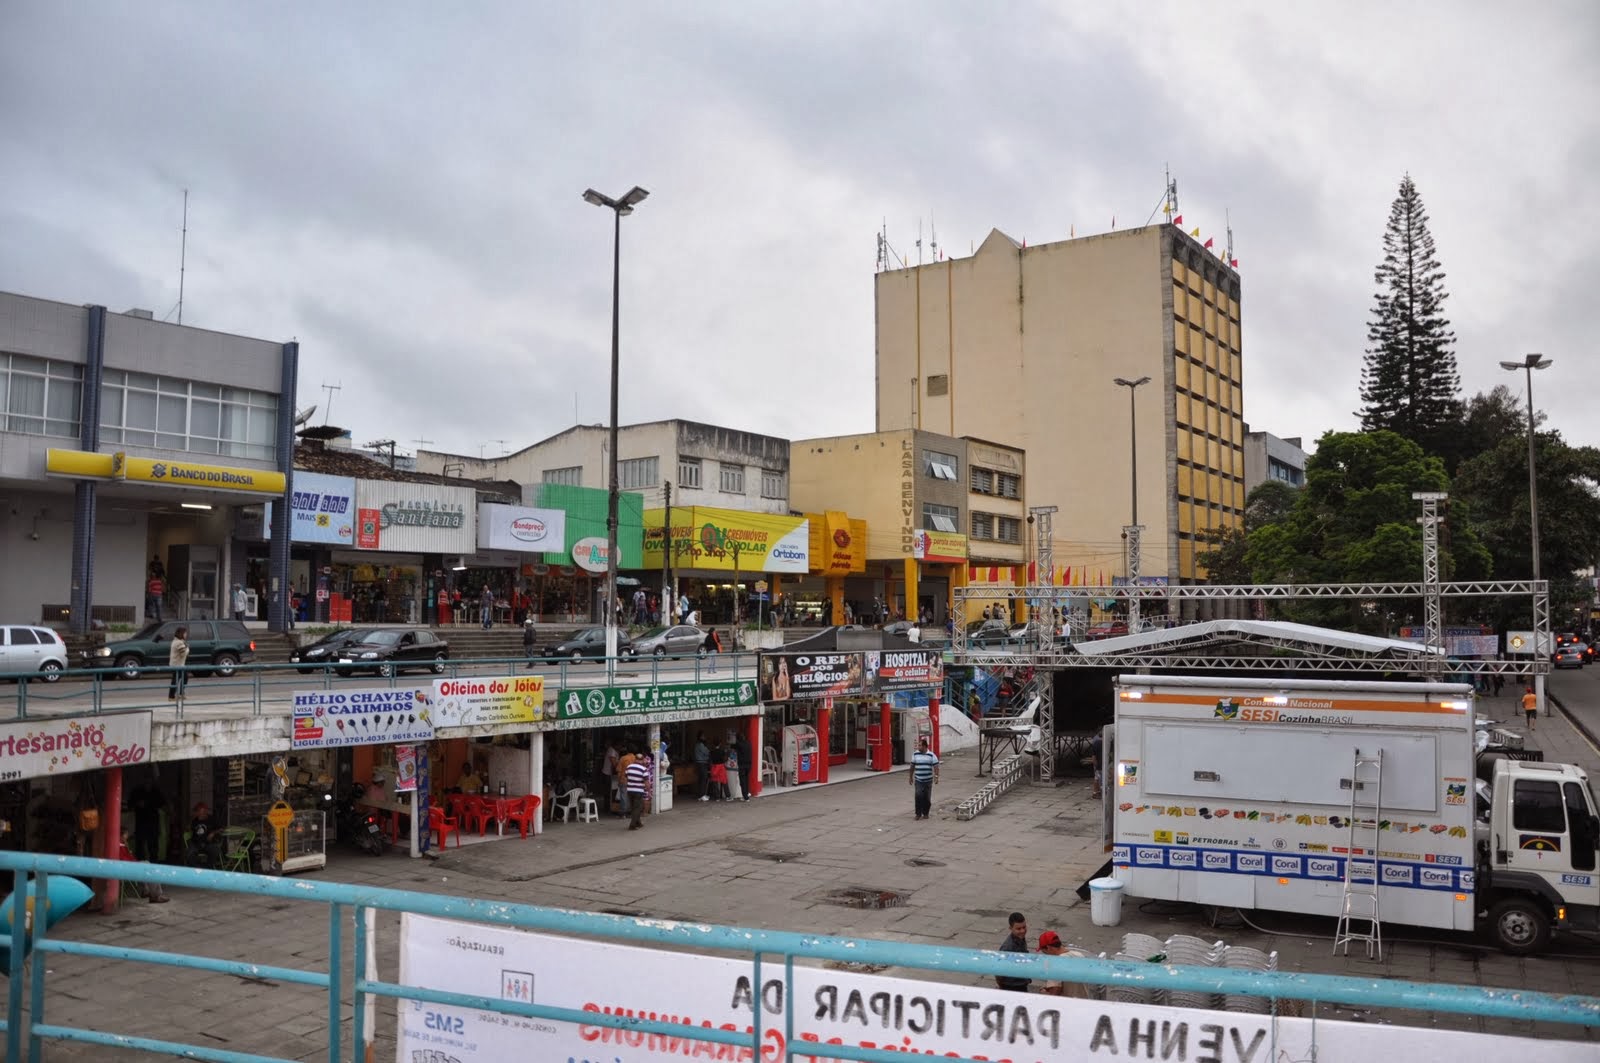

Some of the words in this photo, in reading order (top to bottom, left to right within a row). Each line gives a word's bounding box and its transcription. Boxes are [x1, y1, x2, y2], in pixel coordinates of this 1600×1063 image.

[902, 439, 912, 478] CASA
[171, 465, 206, 481] BANCO
[207, 471, 220, 483] DO
[221, 471, 254, 486] BRASIL
[296, 512, 316, 522] MAIS
[902, 482, 912, 553] BENVINDO
[772, 548, 806, 560] Ortobom
[796, 656, 810, 666] O
[815, 655, 846, 665] REI
[885, 653, 928, 668] HOSPITAL
[894, 669, 904, 677] do
[904, 668, 928, 676] celular
[440, 681, 485, 696] Oficina
[489, 680, 509, 694] das
[514, 678, 542, 693] Jóias
[662, 690, 682, 698] dos
[684, 687, 735, 697] Celulares
[295, 693, 346, 706] HÉLIO
[350, 692, 413, 703] CHAVES
[649, 698, 674, 707] dos
[677, 695, 735, 705] Relógios
[1289, 698, 1333, 709] Nacional
[328, 702, 413, 715] CARIMBOS
[1241, 709, 1280, 722] SESI
[0, 727, 104, 758] rtesanato
[293, 739, 324, 748] LIGUE:
[325, 738, 342, 746] (87)
[344, 735, 386, 744] 3761.4035
[101, 744, 146, 768] Belo
[1192, 836, 1239, 847] PETROBRAS
[1113, 849, 1129, 858] oral
[1139, 850, 1161, 860] Coral
[1172, 852, 1194, 862] Coral
[1205, 854, 1228, 864] Coral
[1239, 856, 1263, 866] Coral
[1275, 858, 1298, 869] Coral
[1438, 855, 1460, 864] SESI
[1311, 861, 1335, 872] Coral
[1384, 867, 1410, 879] Coral
[1423, 870, 1450, 882] Coral
[1565, 874, 1588, 884] SESI
